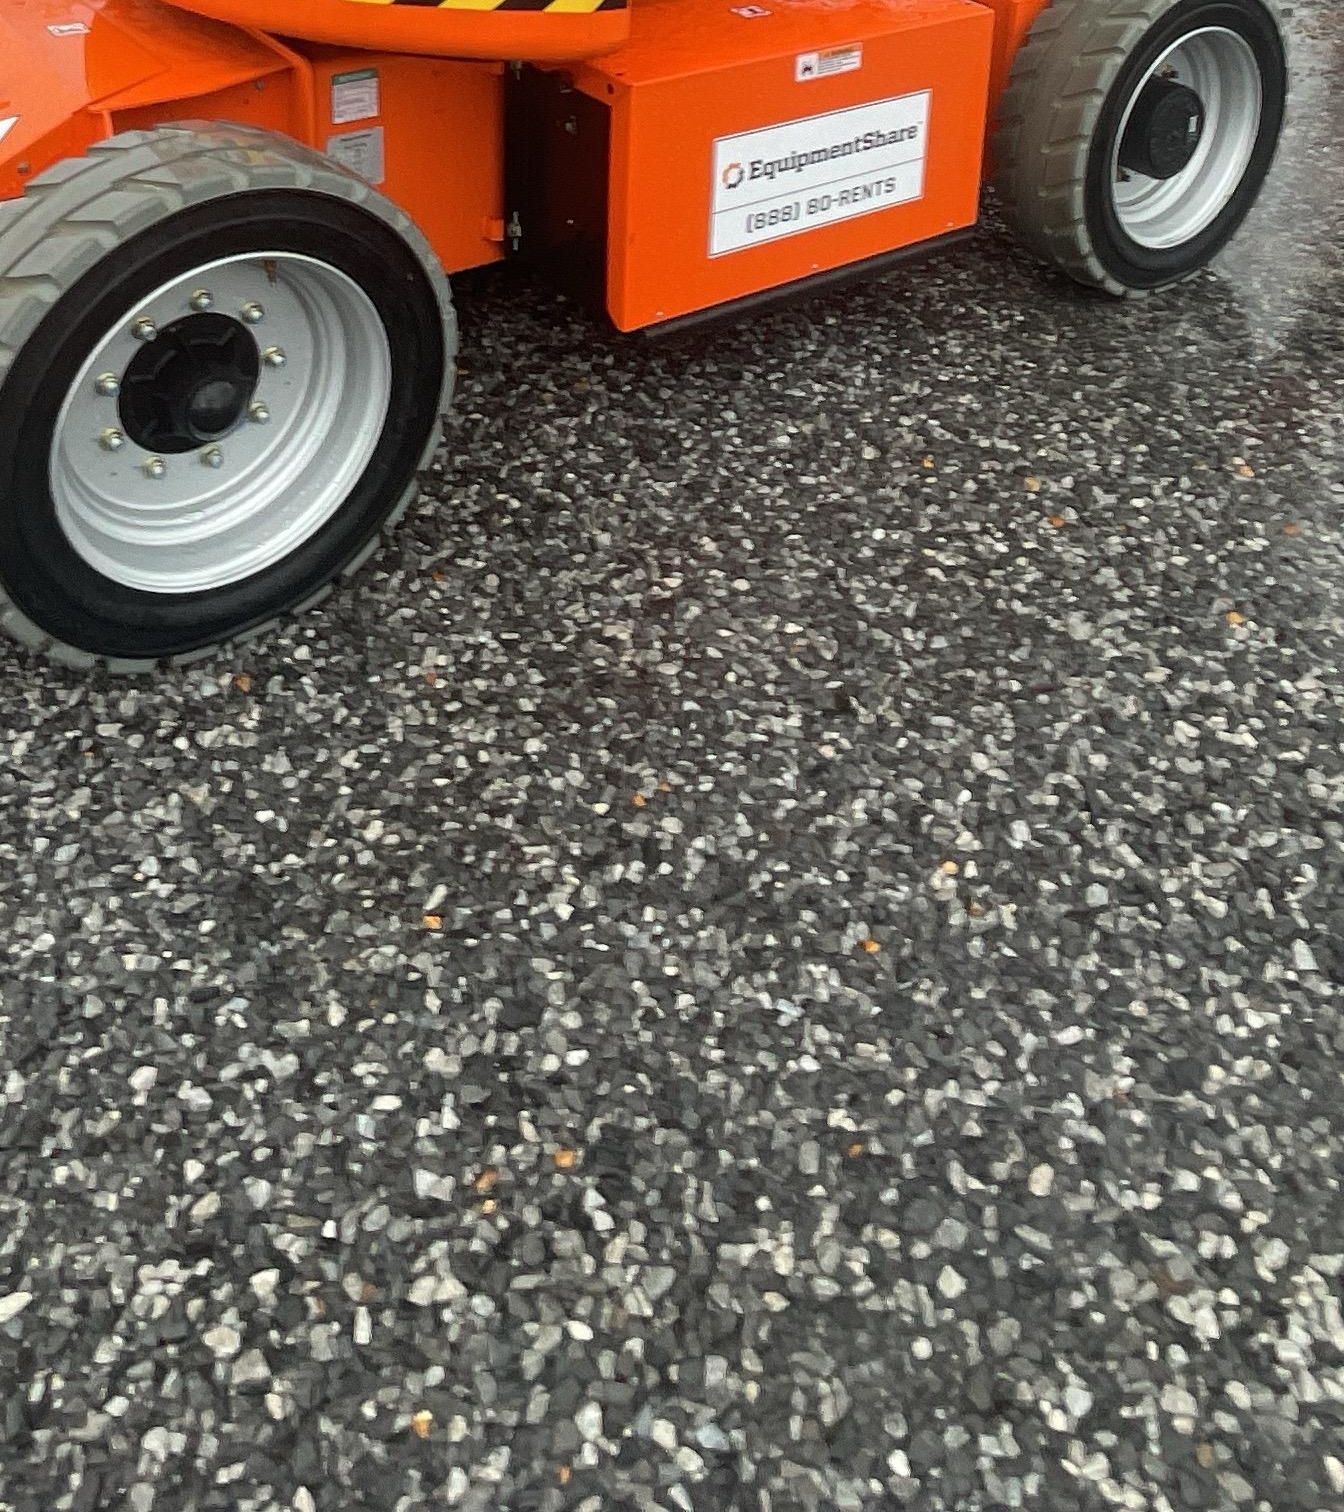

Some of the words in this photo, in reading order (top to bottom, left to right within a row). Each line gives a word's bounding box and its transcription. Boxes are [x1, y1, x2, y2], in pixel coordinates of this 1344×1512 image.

[748, 125, 919, 180] EquipmentShare
[745, 201, 801, 234] (888)
[806, 176, 897, 216] 80-RENTS
